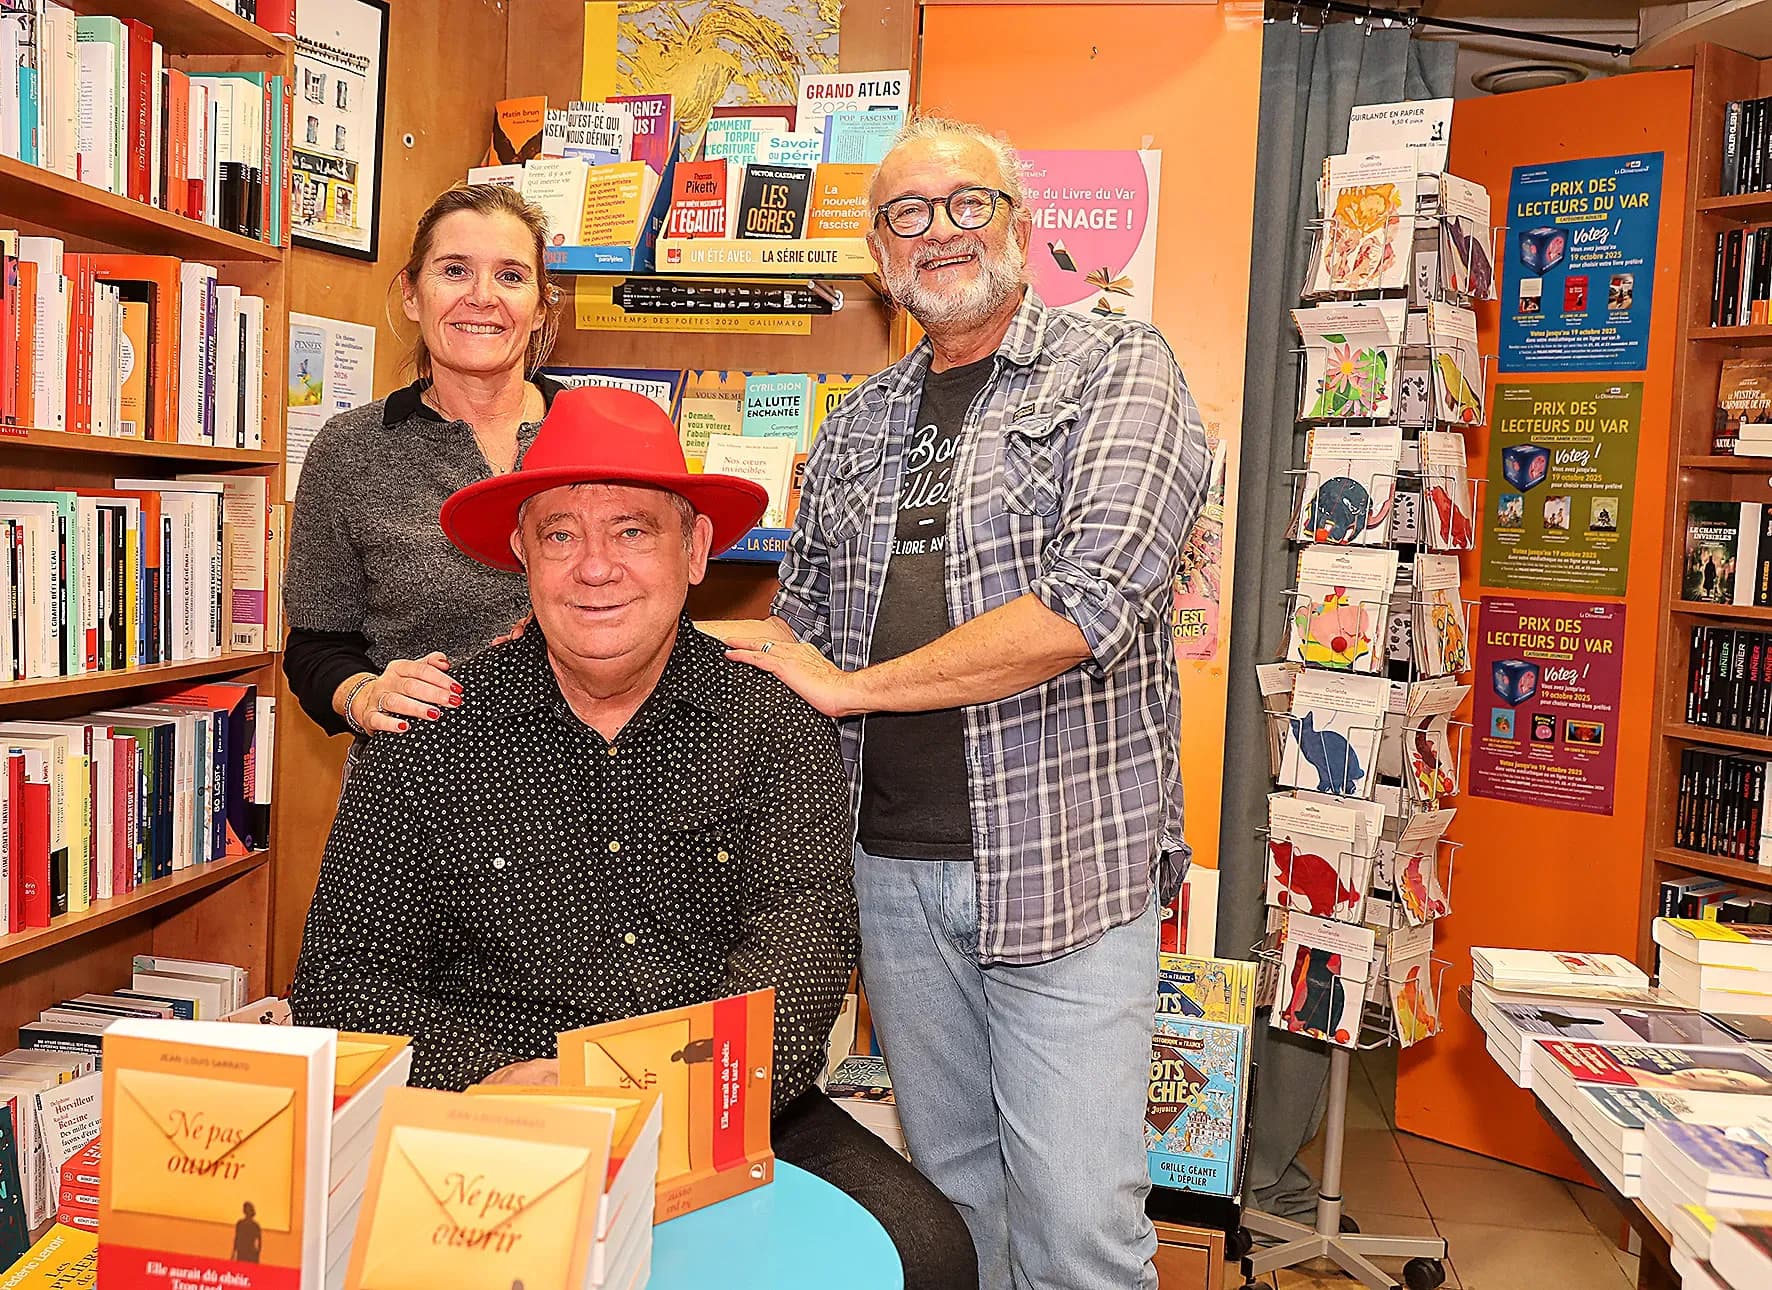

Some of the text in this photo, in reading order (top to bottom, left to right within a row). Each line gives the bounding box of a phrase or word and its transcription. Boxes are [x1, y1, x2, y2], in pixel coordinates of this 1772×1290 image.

[806, 80, 901, 100] GRAND ATLAS
[502, 109, 540, 120] Matin brun
[812, 101, 858, 114] 2026
[1351, 107, 1425, 122] GUIRLANDE EN PAPIER
[567, 113, 620, 132] QU'EST-CE QUI
[707, 119, 752, 132] COMMENT
[136, 91, 147, 171] LIVRE ROUGE
[565, 129, 623, 149] NOUS DÉFINIT ?
[770, 137, 820, 149] Savoir
[705, 143, 756, 155] L'ÉCRITURE
[768, 148, 821, 163] ou périr
[693, 172, 713, 181] Thomas
[750, 169, 806, 181] VICTOR CASTANET
[612, 179, 632, 187] artistes
[685, 180, 718, 196] Piketty
[824, 184, 838, 195] La
[1550, 177, 1617, 197] PRIX DES
[597, 187, 616, 195] queers
[761, 183, 789, 208] LES
[1043, 187, 1136, 201] du Livre du Var
[595, 200, 626, 208] inadaptées
[822, 196, 868, 206] nouvelle
[1517, 192, 1650, 218] LECTEURS DU VAR
[592, 219, 635, 228] neuroatypiques
[594, 213, 625, 221] handicapés
[670, 206, 726, 234] L'ÉGALITÉ
[746, 207, 796, 234] OGRES
[818, 219, 860, 230] fasciste
[1125, 208, 1134, 230] !
[591, 228, 613, 236] parents
[591, 235, 613, 243] pauvres
[1573, 219, 1622, 245] Votez !
[690, 247, 838, 264] UN ÉTÉ LA SÉRIE CULTE
[1580, 253, 1604, 261] octobre
[1604, 251, 1623, 260] 2025
[596, 316, 648, 324] PRINTEMPS
[652, 317, 671, 325] DES
[675, 316, 711, 326] POÈTES
[715, 319, 741, 327] 2020
[748, 319, 804, 328] GALLIMARD
[207, 335, 215, 363] MEUTE
[333, 370, 349, 380] 2026
[749, 381, 802, 393] CYRIL DION
[1733, 388, 1761, 400] MYSTÈRE
[695, 391, 729, 400] VOUS NE
[748, 395, 801, 409] LA LUTTE
[1533, 401, 1597, 416] PRIX DES
[1721, 399, 1750, 410] L'ARMOIRE
[688, 411, 716, 421] Demain,
[747, 407, 800, 418] ENCHANTÉE
[687, 421, 731, 431] vous voterez
[771, 423, 799, 431] Comment
[1500, 418, 1630, 434] LECTEURS DU VAR
[686, 439, 706, 448] peine
[724, 456, 768, 467] Nos cœurs
[1554, 442, 1602, 468] Votez !
[721, 466, 767, 475] invincibles
[1552, 473, 1603, 482] 19 octobre 2025
[1689, 526, 1699, 534] LE
[1698, 527, 1723, 535] CHANT
[1693, 533, 1732, 541] INVISIBLES
[747, 537, 761, 550] LA
[51, 571, 58, 581] DE
[1180, 608, 1206, 624] EST
[51, 628, 58, 637] LE
[1518, 616, 1583, 634] PRIX DES
[1487, 631, 1614, 655] LECTEURS DU VAR
[1719, 641, 1730, 678] MINIER
[1735, 642, 1746, 680] MINIER
[1750, 644, 1760, 682] MINIER
[1764, 646, 1772, 683] MINIER
[1543, 663, 1590, 686] Votez !
[1541, 690, 1591, 702] 19 octobre 2025
[1149, 1059, 1185, 1081] OTS
[720, 1041, 730, 1130] Elle aurait dû obéir.
[729, 1060, 740, 1106] Trop tard.
[1148, 1076, 1202, 1107] CHÉS
[55, 1094, 95, 1115] Horvilleur
[58, 1113, 88, 1130] Benzine
[167, 1109, 243, 1150] Ne pas
[167, 1153, 246, 1182] ouvrir
[1160, 1161, 1218, 1179] GRILLE GÉANTE
[1169, 1170, 1208, 1187] À DÉPLIER
[443, 1171, 526, 1217] Ne pas
[432, 1223, 523, 1253] ouvrir
[34, 1236, 65, 1262] Lenoir
[45, 1262, 71, 1278] Les
[146, 1261, 251, 1287] Elle aurait dû obéir.
